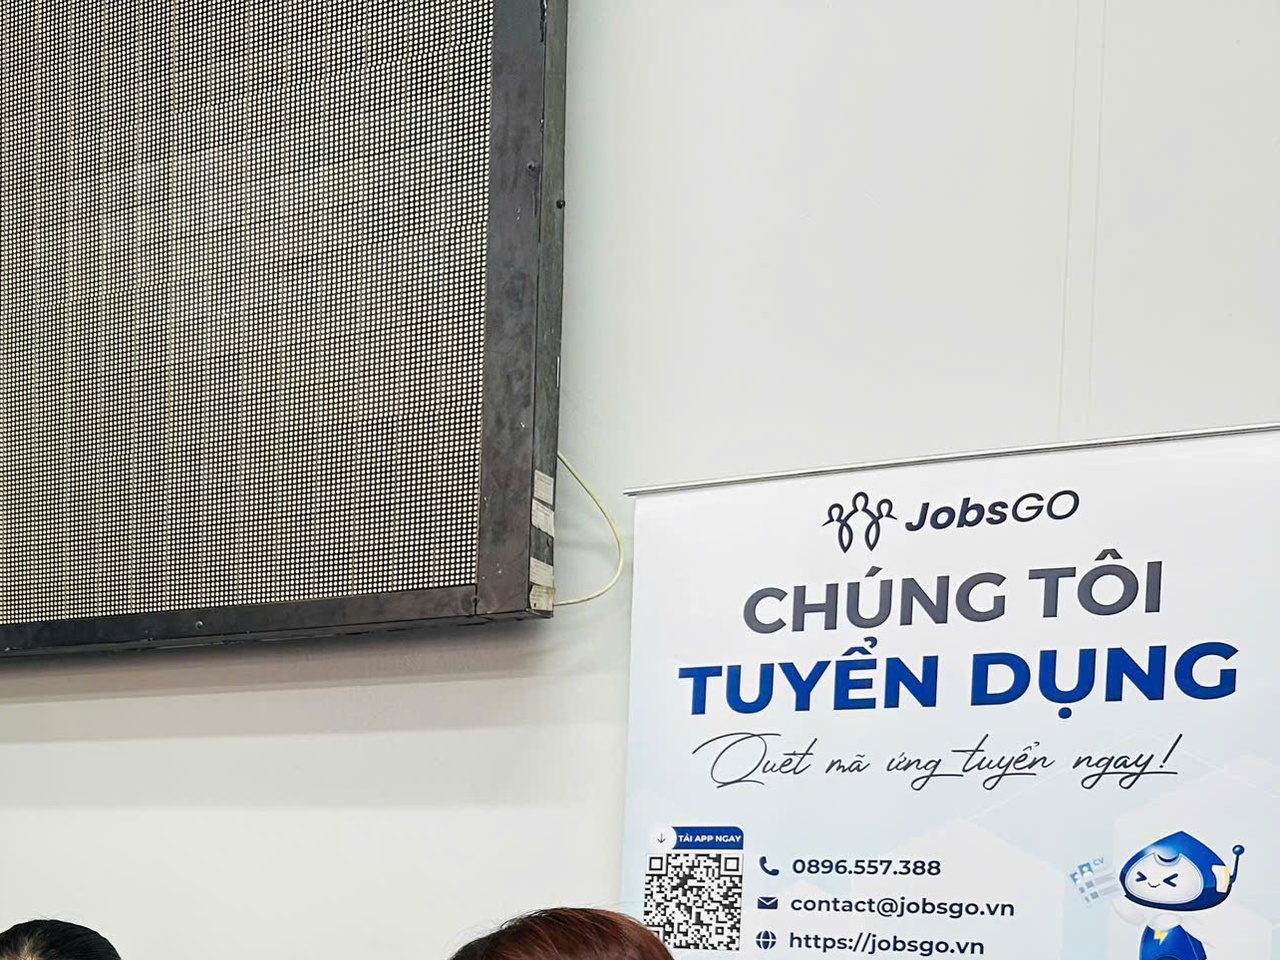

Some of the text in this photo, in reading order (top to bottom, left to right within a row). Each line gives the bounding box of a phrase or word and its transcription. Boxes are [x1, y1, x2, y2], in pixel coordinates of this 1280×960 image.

[905, 489, 1080, 532] JobsGO
[742, 548, 1164, 635] CHÚNG TÔI
[678, 636, 1239, 720] TUYỂN DỤNG
[825, 754, 870, 774] mã
[885, 752, 964, 792] ứng
[951, 733, 1055, 792] tuyển
[1071, 732, 1183, 791] ngay!
[678, 832, 742, 843] TẢI APP NGAY
[792, 858, 942, 876] 0896.557.388
[1093, 857, 1104, 866] CV
[790, 896, 1015, 919] contact@jobsgo.vn
[789, 932, 985, 957] https://jobsgo.vn
